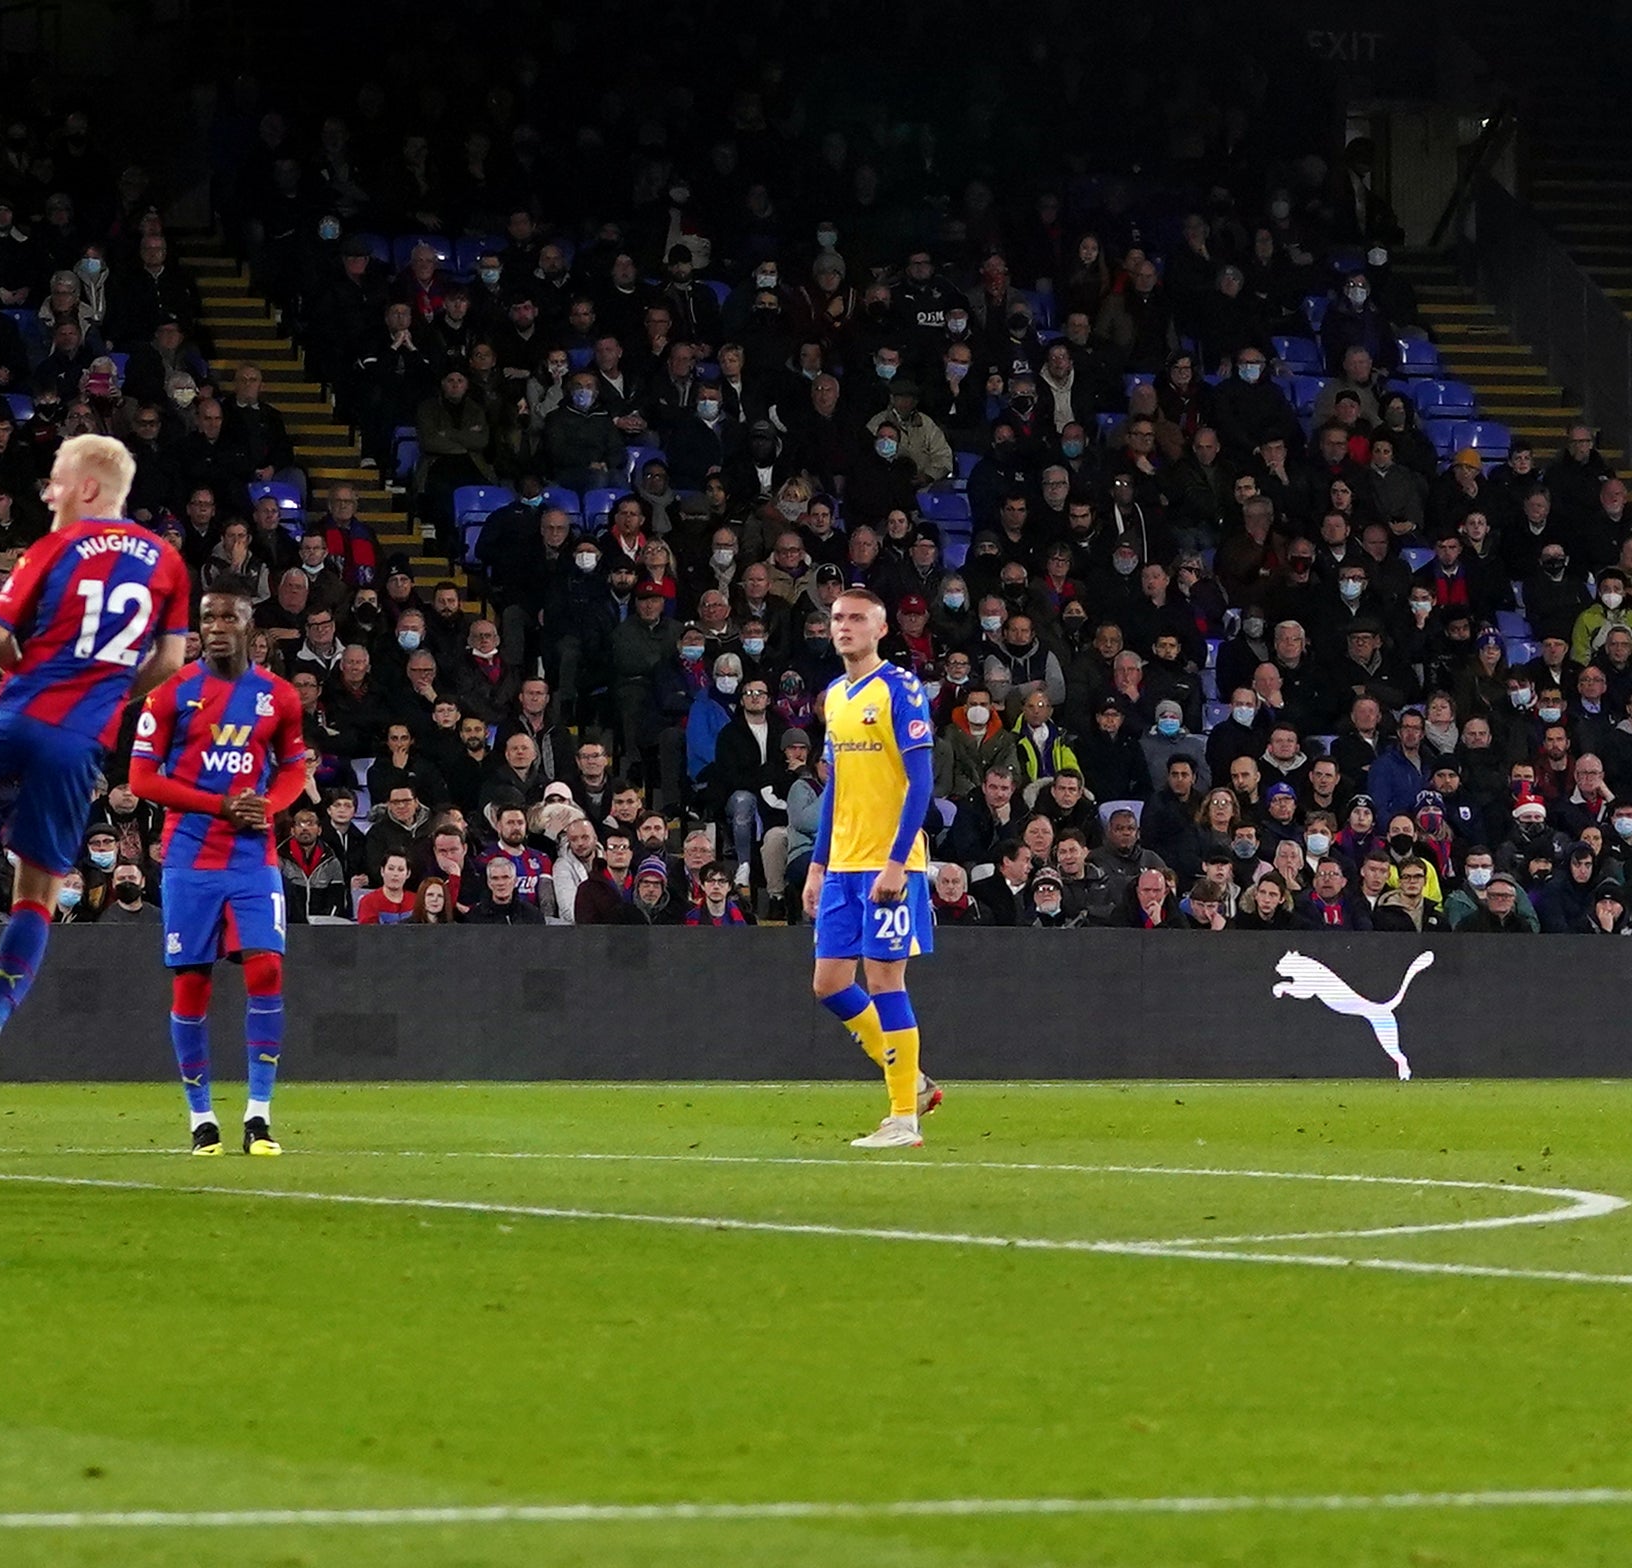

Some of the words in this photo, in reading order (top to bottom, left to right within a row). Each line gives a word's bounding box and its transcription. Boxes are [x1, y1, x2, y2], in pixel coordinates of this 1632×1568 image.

[75, 534, 160, 566] HUGHES
[74, 578, 153, 667] 12
[200, 750, 255, 774] W88
[874, 905, 910, 938] 20
